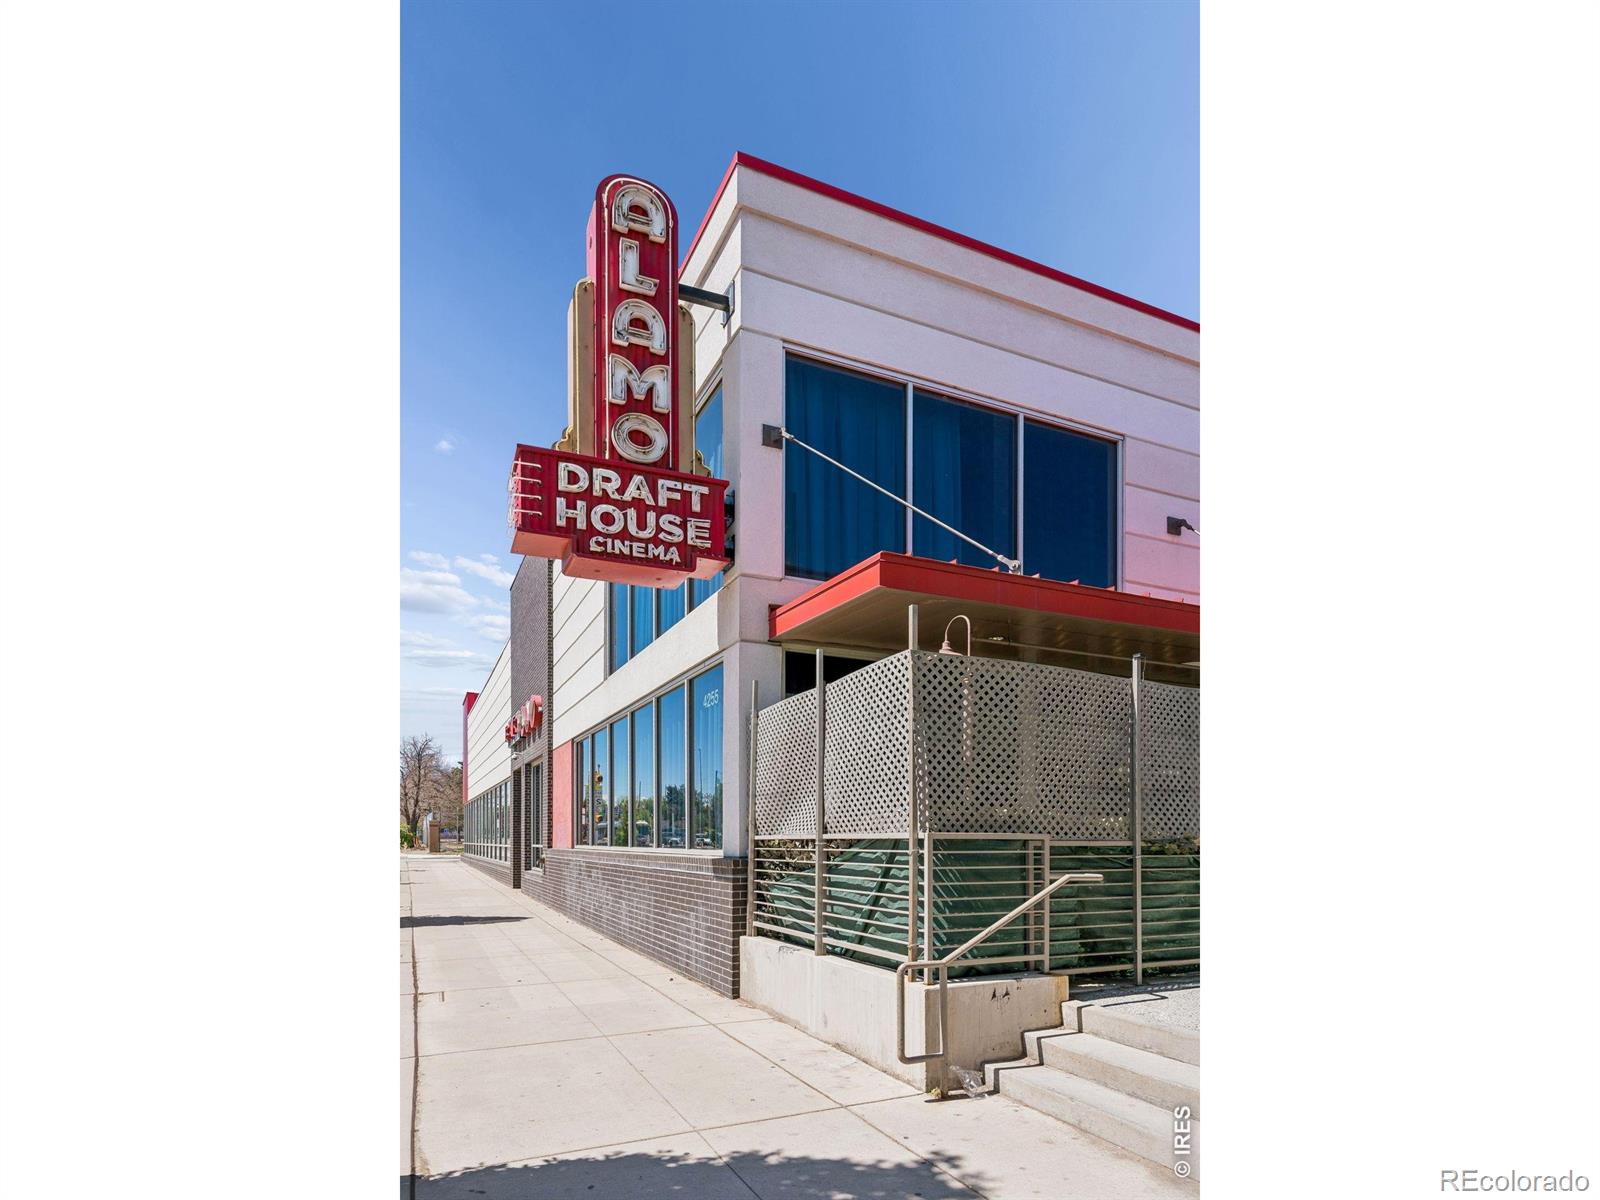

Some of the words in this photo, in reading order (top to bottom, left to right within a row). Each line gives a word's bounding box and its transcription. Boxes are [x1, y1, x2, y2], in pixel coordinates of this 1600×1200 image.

[608, 184, 671, 464] ALAMO
[557, 461, 709, 513] DRAFT
[556, 496, 712, 549] HOUSE
[589, 535, 681, 564] CINEMA
[703, 688, 719, 707] 4255
